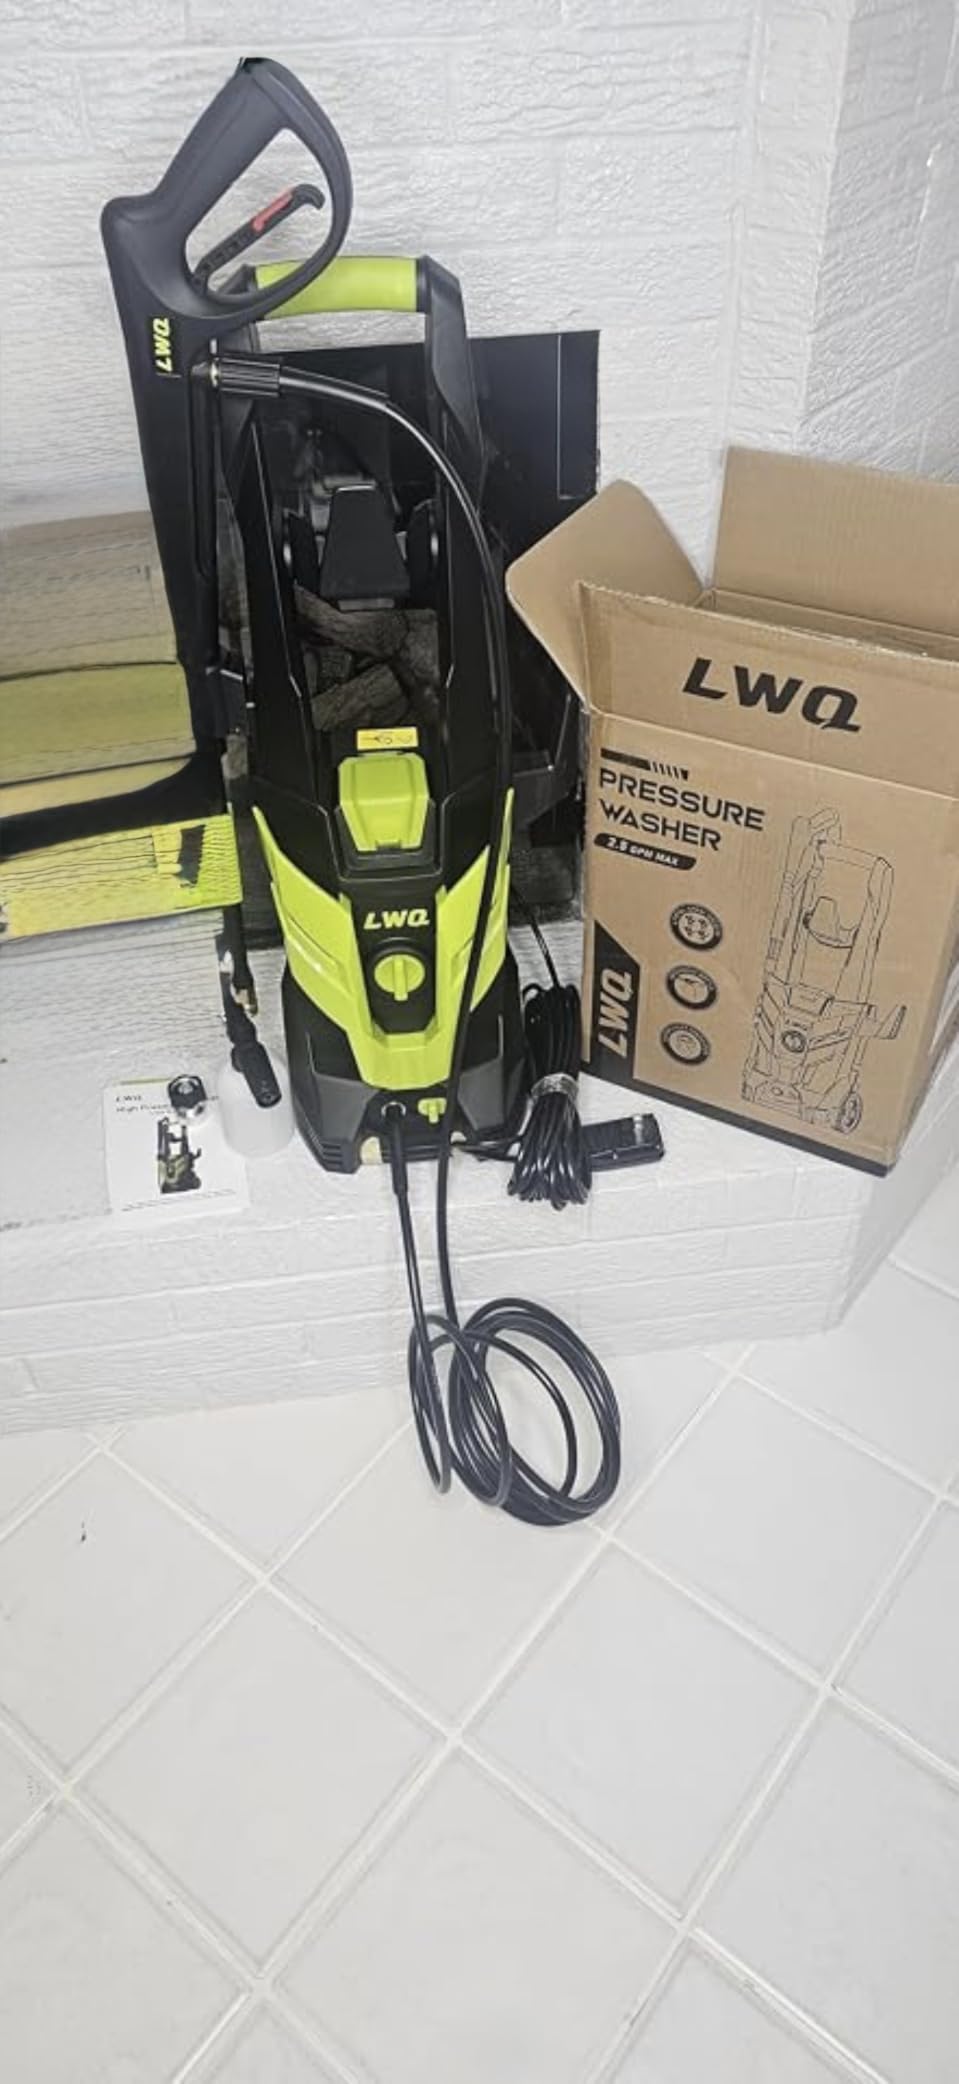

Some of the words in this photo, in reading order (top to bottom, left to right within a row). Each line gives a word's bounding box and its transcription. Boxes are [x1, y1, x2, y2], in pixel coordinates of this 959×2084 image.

[153, 318, 173, 372] LWQ
[683, 657, 861, 732] LWQ
[599, 798, 721, 851] WASHER
[600, 768, 765, 831] PRESSURE
[629, 845, 653, 858] GPM
[655, 852, 679, 866] MAX
[364, 908, 430, 929] LWQ
[598, 968, 633, 1059] LWQ
